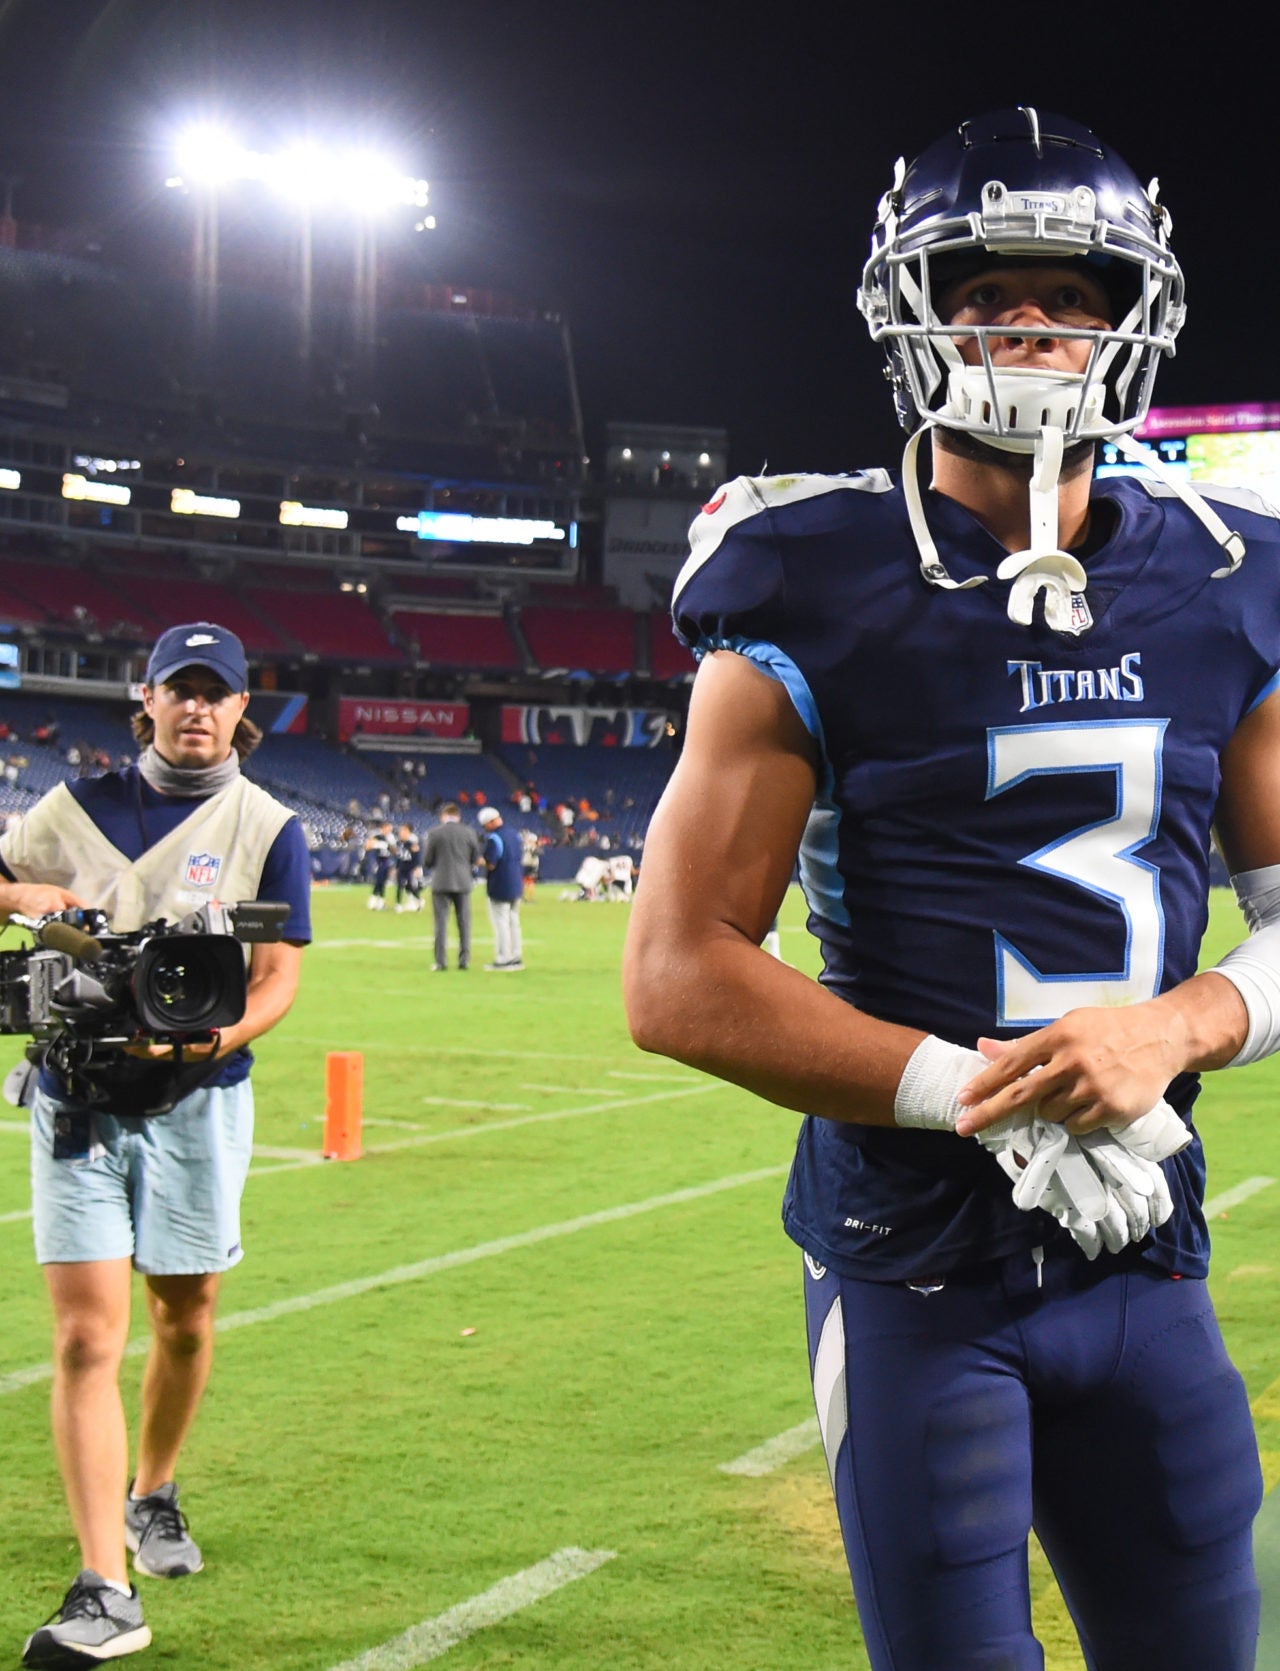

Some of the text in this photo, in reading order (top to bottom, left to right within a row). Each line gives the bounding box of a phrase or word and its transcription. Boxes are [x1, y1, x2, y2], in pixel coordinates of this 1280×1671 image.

[1020, 198, 1058, 212] TITANS
[1007, 652, 1144, 712] TITANS
[355, 704, 454, 726] NISSAN
[188, 866, 214, 884] NFL
[984, 718, 1171, 1027] 3
[843, 1217, 893, 1236] DRI-FIT
